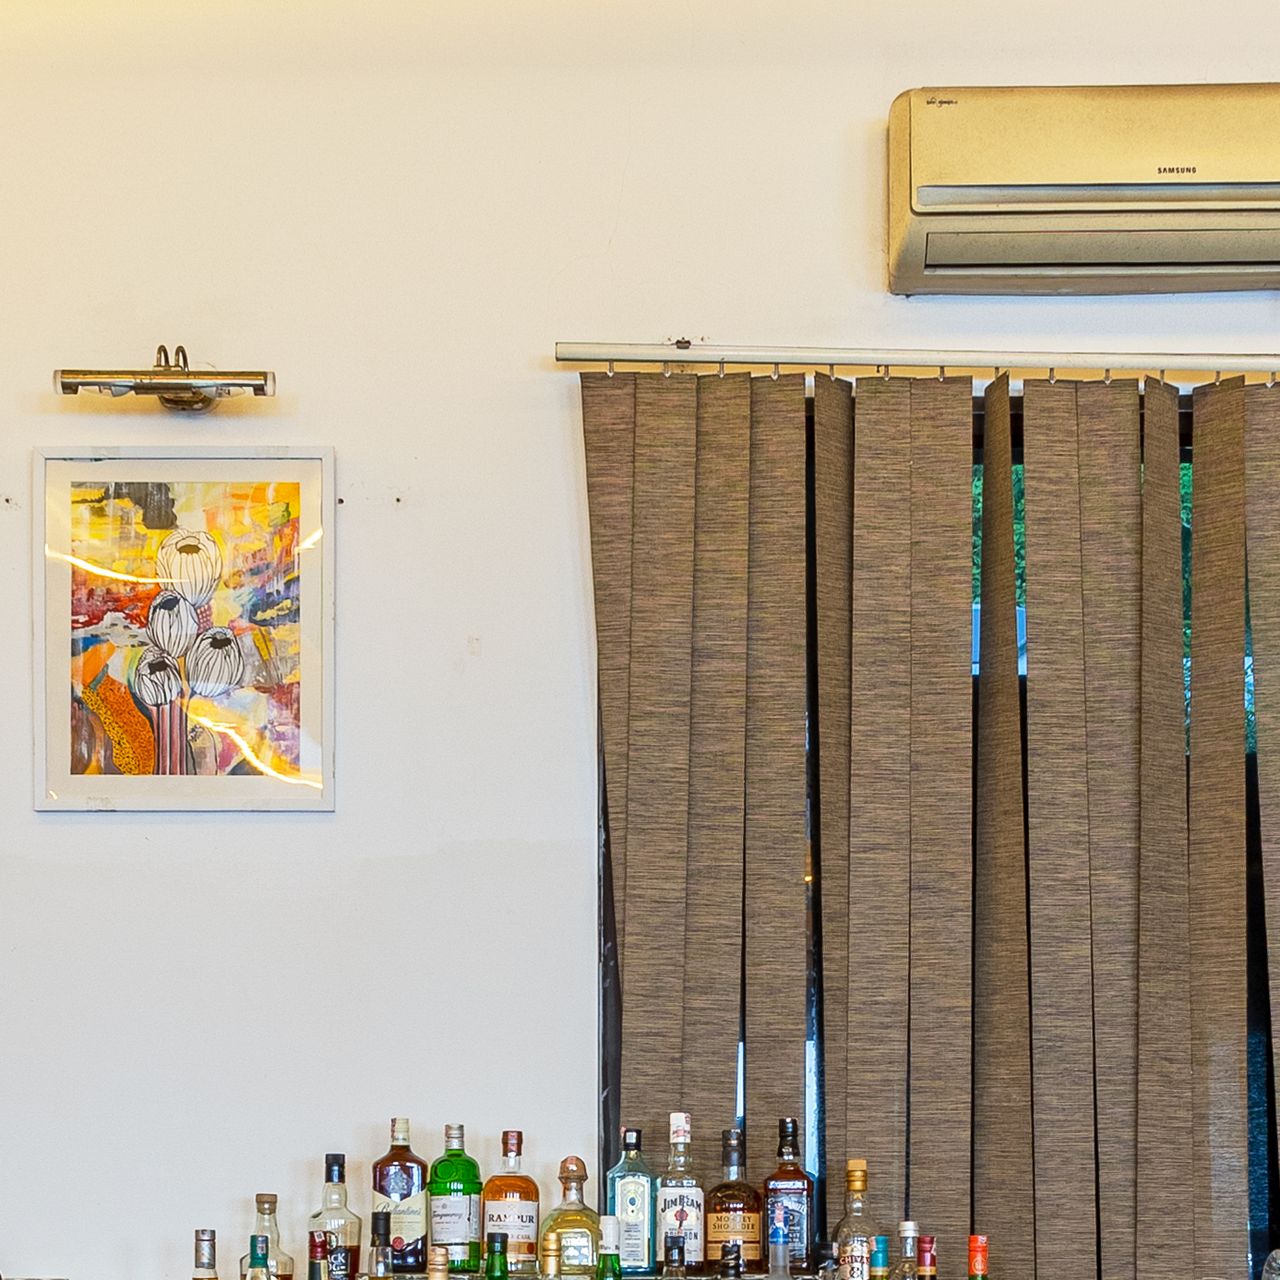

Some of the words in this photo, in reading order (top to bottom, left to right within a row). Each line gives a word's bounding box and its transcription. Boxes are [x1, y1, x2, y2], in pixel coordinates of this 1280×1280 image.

[1157, 166, 1197, 174] SAMSUNG
[661, 1198, 678, 1213] JIM
[678, 1195, 702, 1212] BEAM
[488, 1213, 535, 1225] RAUR
[715, 1215, 753, 1223] MOEY
[712, 1223, 756, 1231] SHODER
[664, 1231, 699, 1241] BOBON
